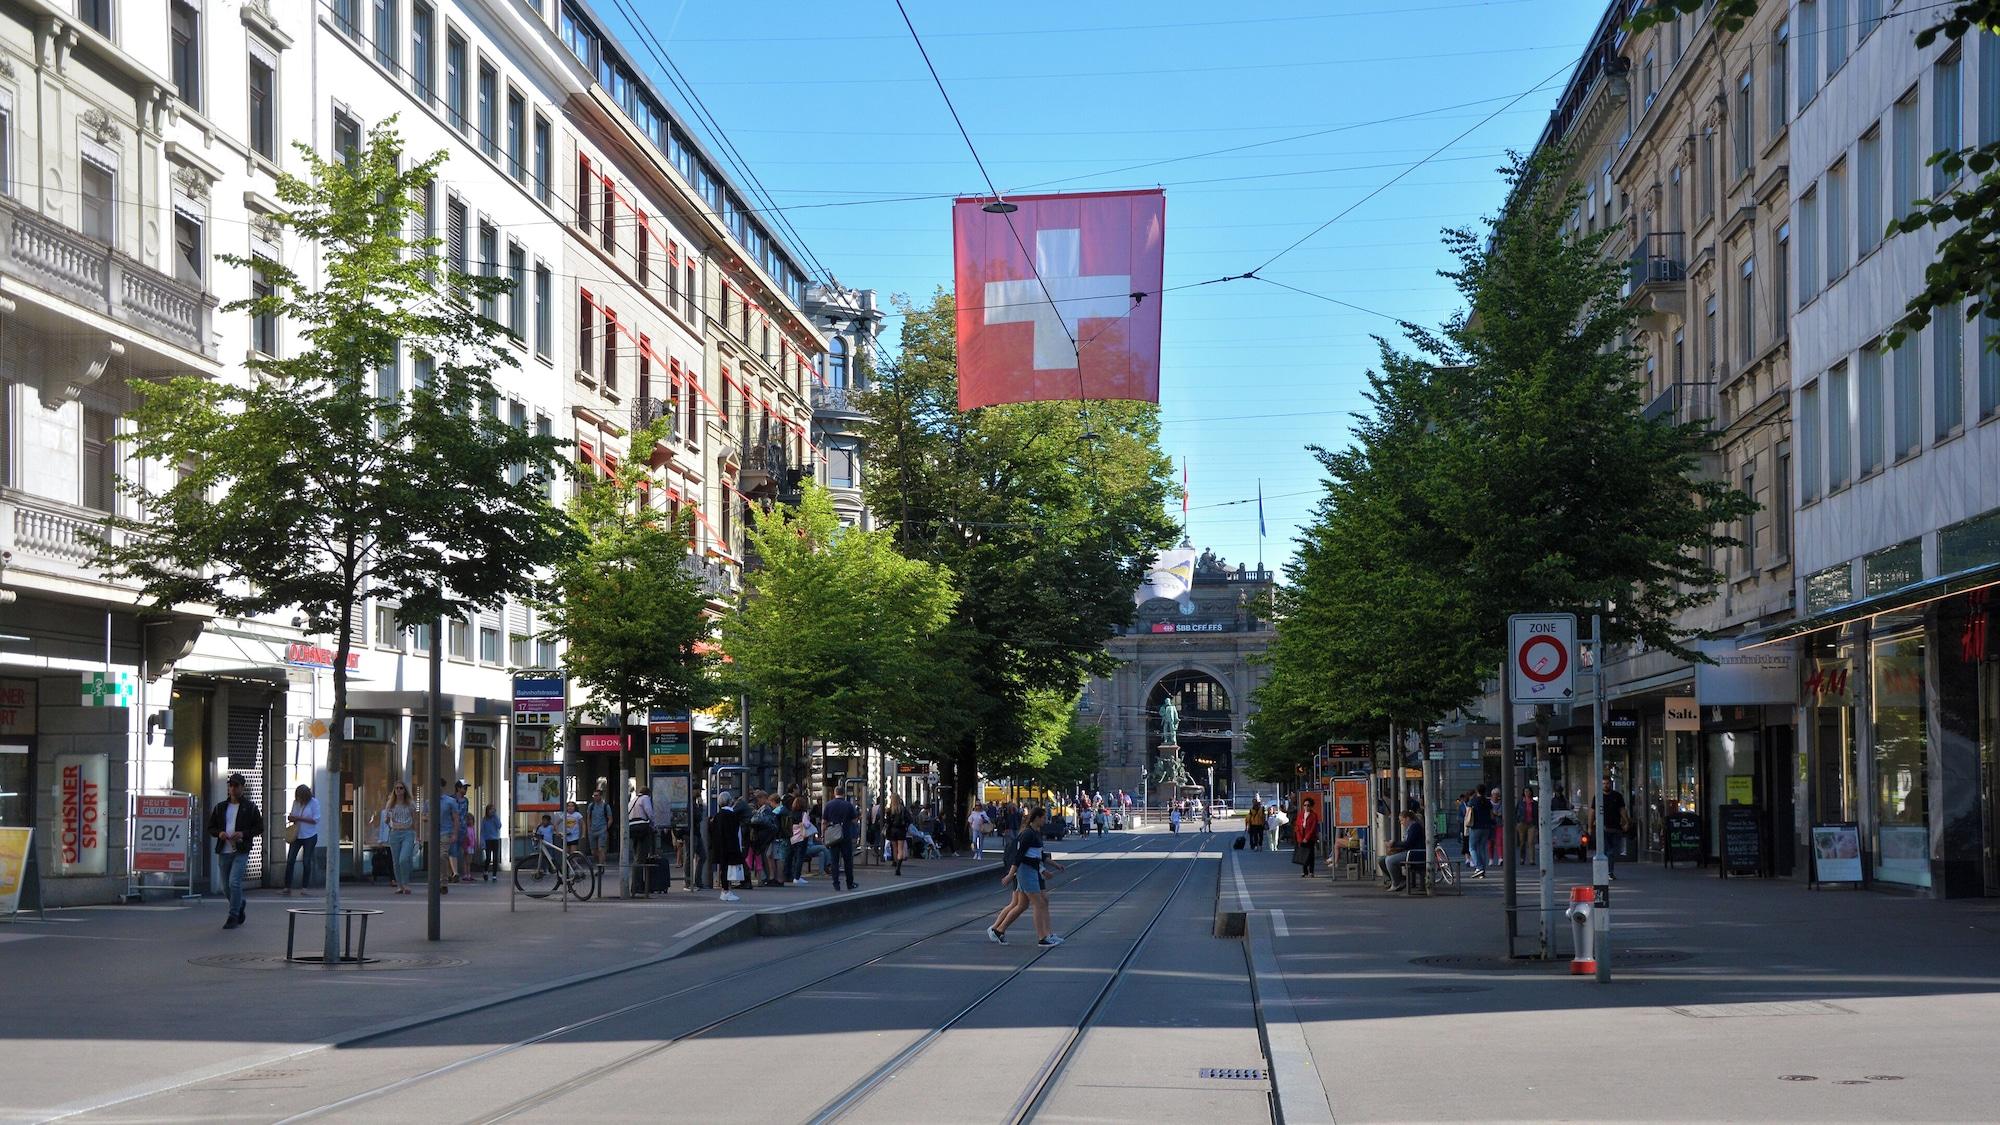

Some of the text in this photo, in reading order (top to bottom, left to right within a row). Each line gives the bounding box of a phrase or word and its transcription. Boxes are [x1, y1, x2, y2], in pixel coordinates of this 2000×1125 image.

[1176, 624, 1223, 632] SBB CFF FFS
[1529, 623, 1557, 633] ZONE
[288, 643, 332, 666] OCHSNER
[1804, 668, 1848, 697] H&M
[0, 688, 25, 704] NER
[516, 689, 559, 697] Bahnhofstrasse
[518, 703, 527, 711] 17
[1667, 708, 1698, 719] Salt.
[585, 739, 623, 747] BELDON
[143, 799, 170, 807] HEUTE
[62, 765, 78, 864] OCHSNER
[82, 779, 97, 849] SPORT
[143, 807, 166, 815] CLUB
[141, 824, 180, 842] 20%
